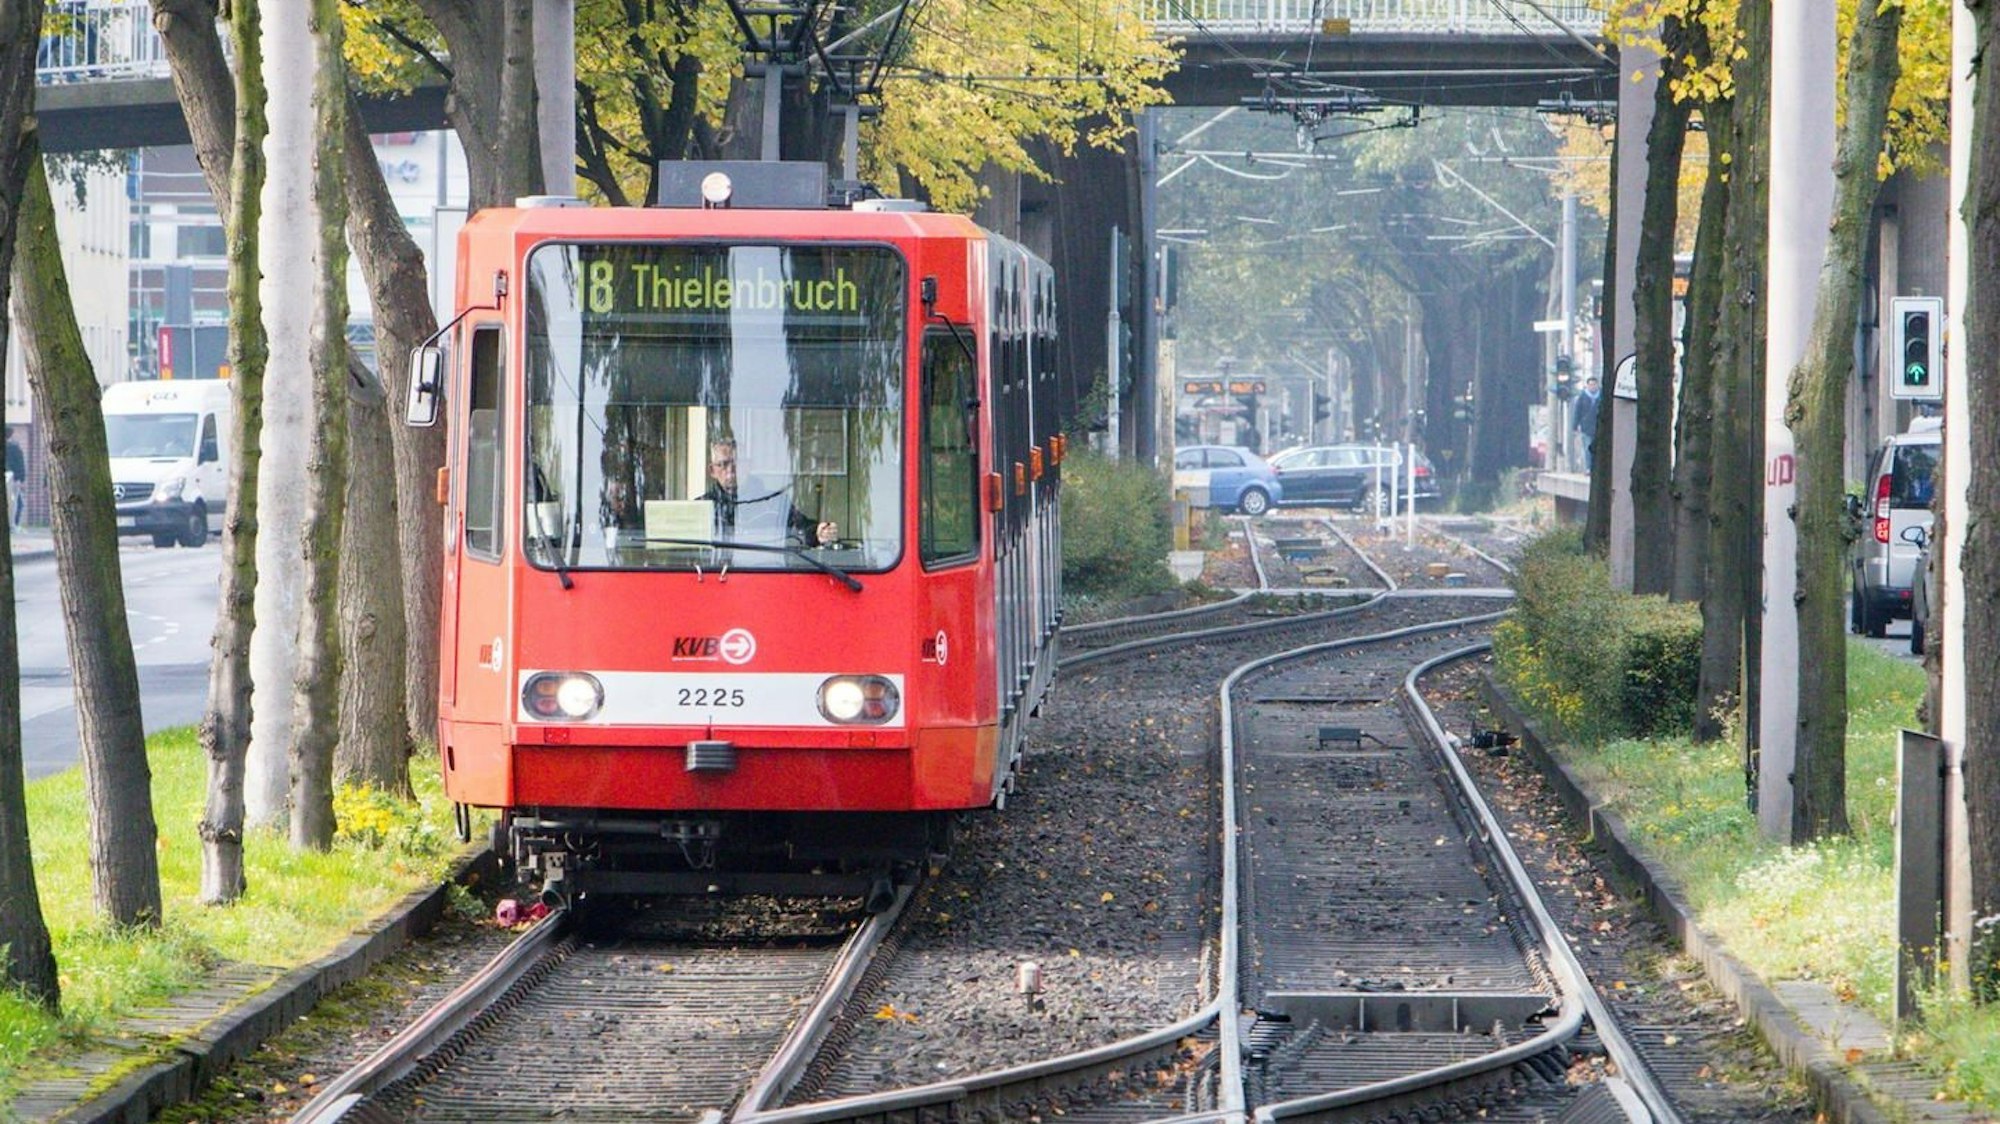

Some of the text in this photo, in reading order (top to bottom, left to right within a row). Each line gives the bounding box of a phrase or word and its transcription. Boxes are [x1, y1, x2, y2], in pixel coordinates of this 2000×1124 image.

[572, 259, 858, 313] 18 Thielenbruch
[671, 636, 720, 657] KVB
[678, 688, 745, 707] 2225
